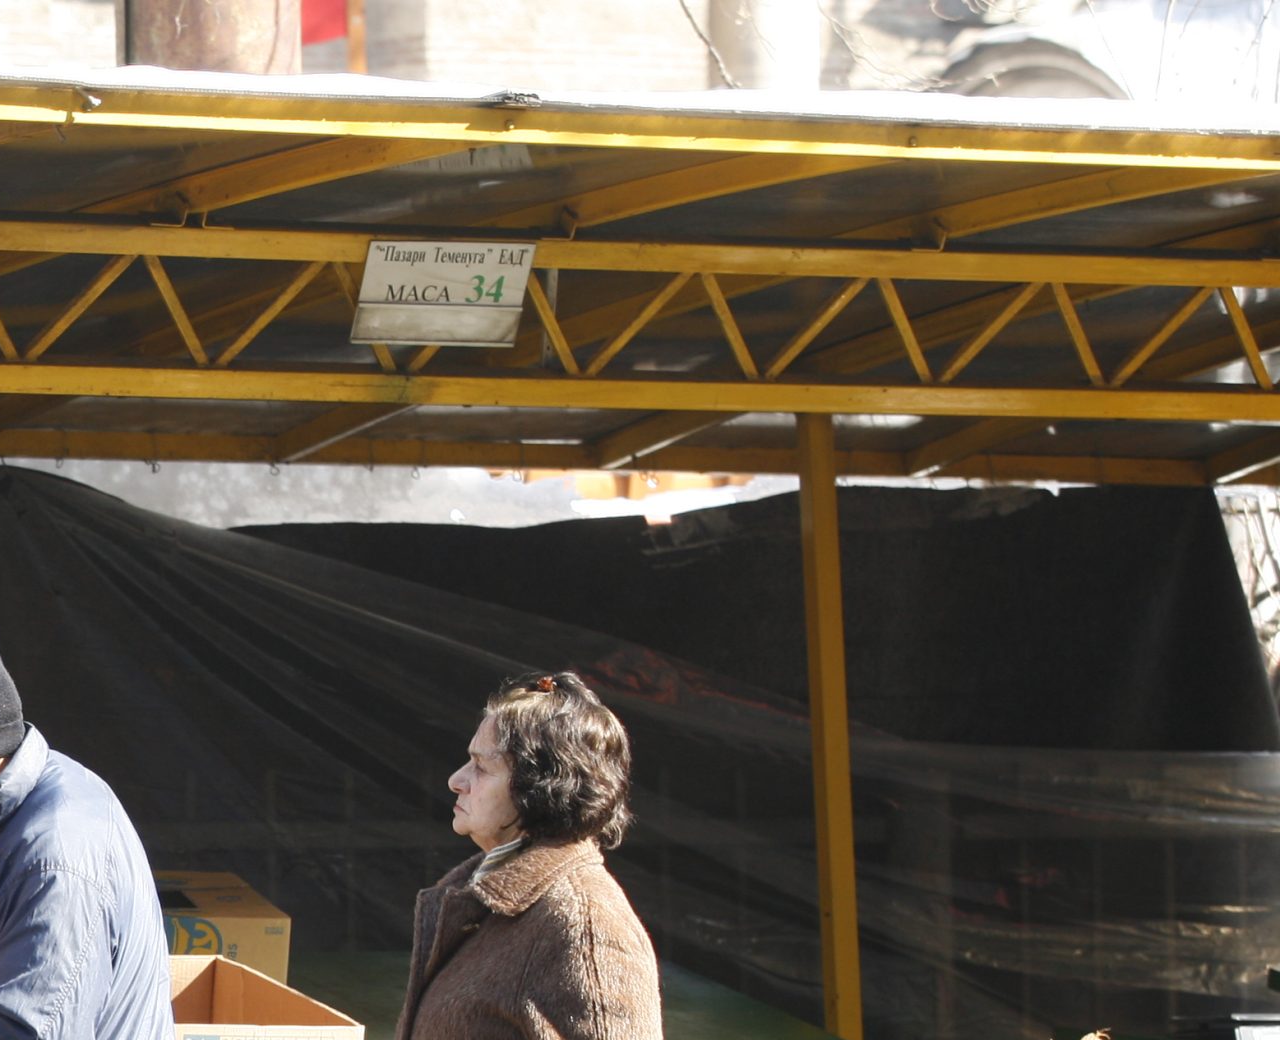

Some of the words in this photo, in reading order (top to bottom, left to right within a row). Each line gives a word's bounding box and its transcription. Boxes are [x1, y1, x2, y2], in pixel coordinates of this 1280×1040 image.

[498, 248, 525, 266] ЕАД
[384, 284, 450, 302] МАСА
[465, 274, 505, 304] 34
